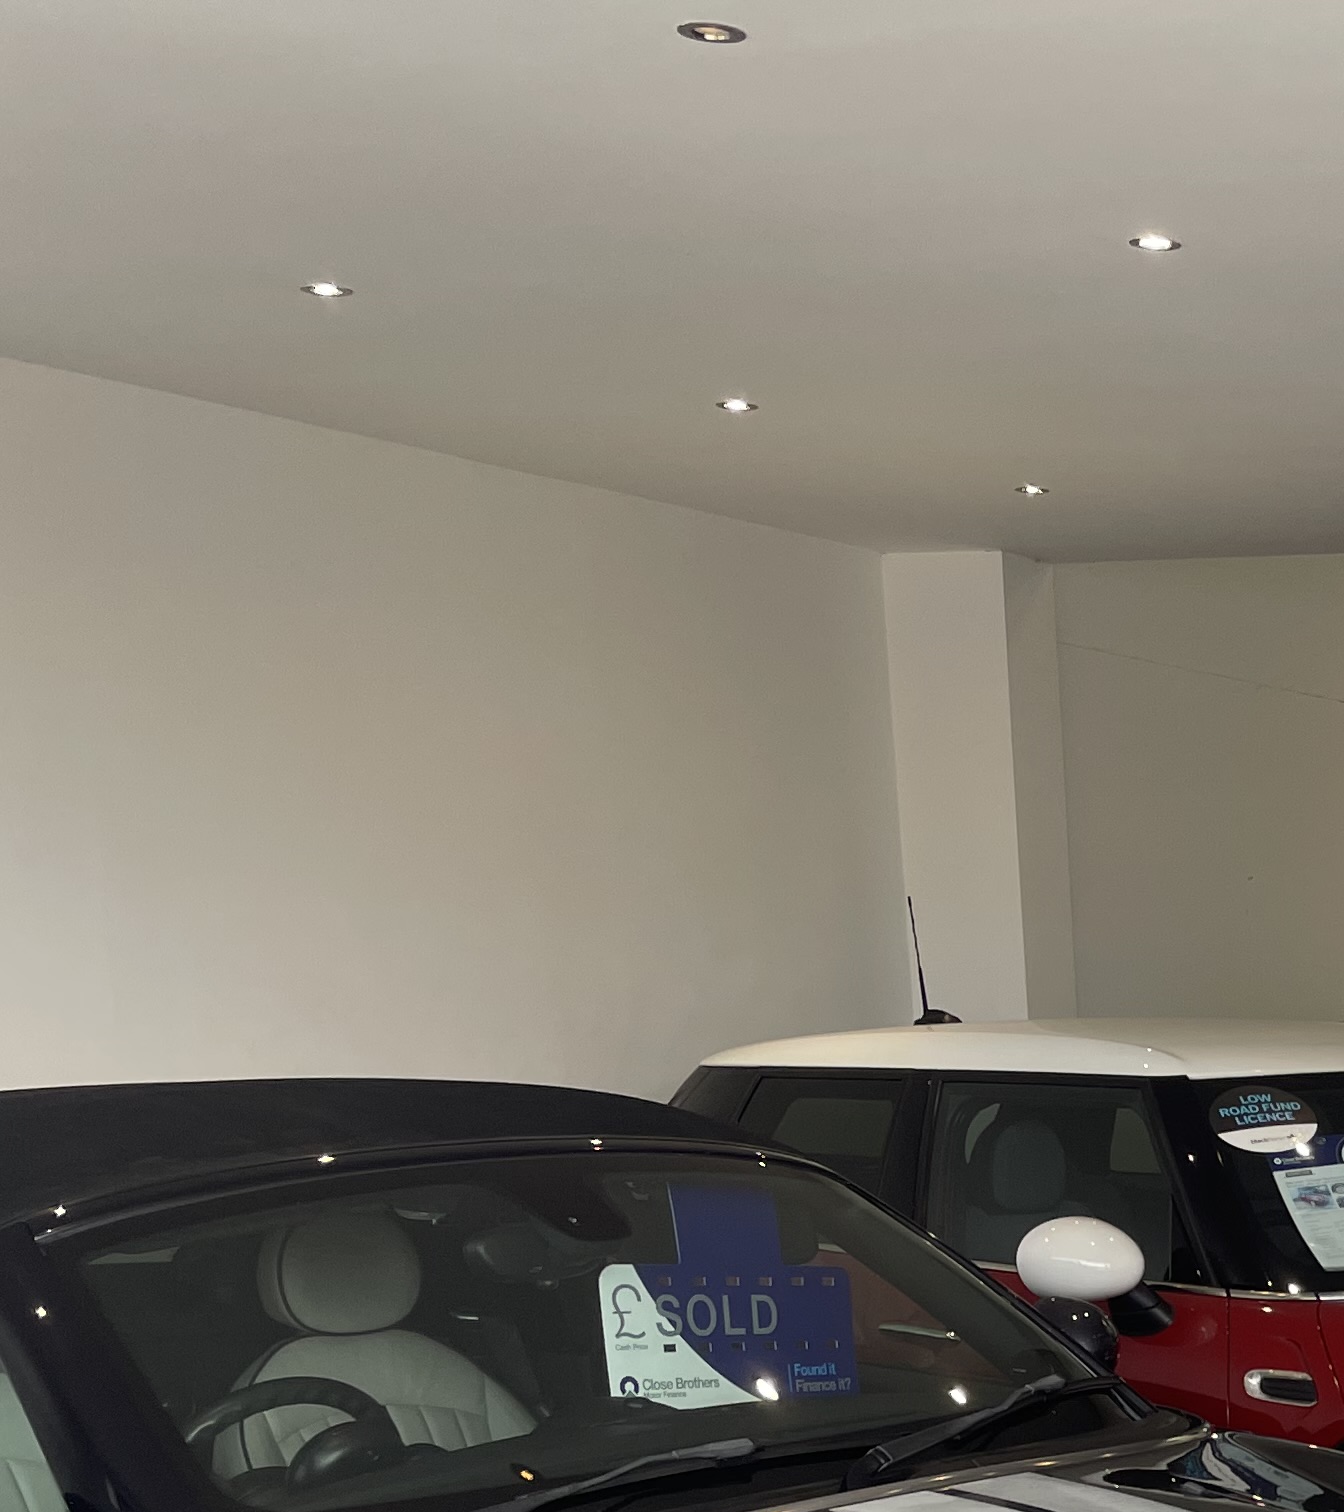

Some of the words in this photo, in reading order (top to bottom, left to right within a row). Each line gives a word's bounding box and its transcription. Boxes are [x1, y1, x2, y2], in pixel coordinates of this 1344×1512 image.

[1239, 1093, 1272, 1104] LOW
[1219, 1104, 1259, 1118] ROAD
[1262, 1101, 1301, 1112] FUND
[1235, 1111, 1296, 1126] LICENCE
[655, 1293, 779, 1338] SOLD
[793, 1362, 828, 1377] Found
[642, 1378, 674, 1391] Close
[676, 1376, 720, 1390] Brothers
